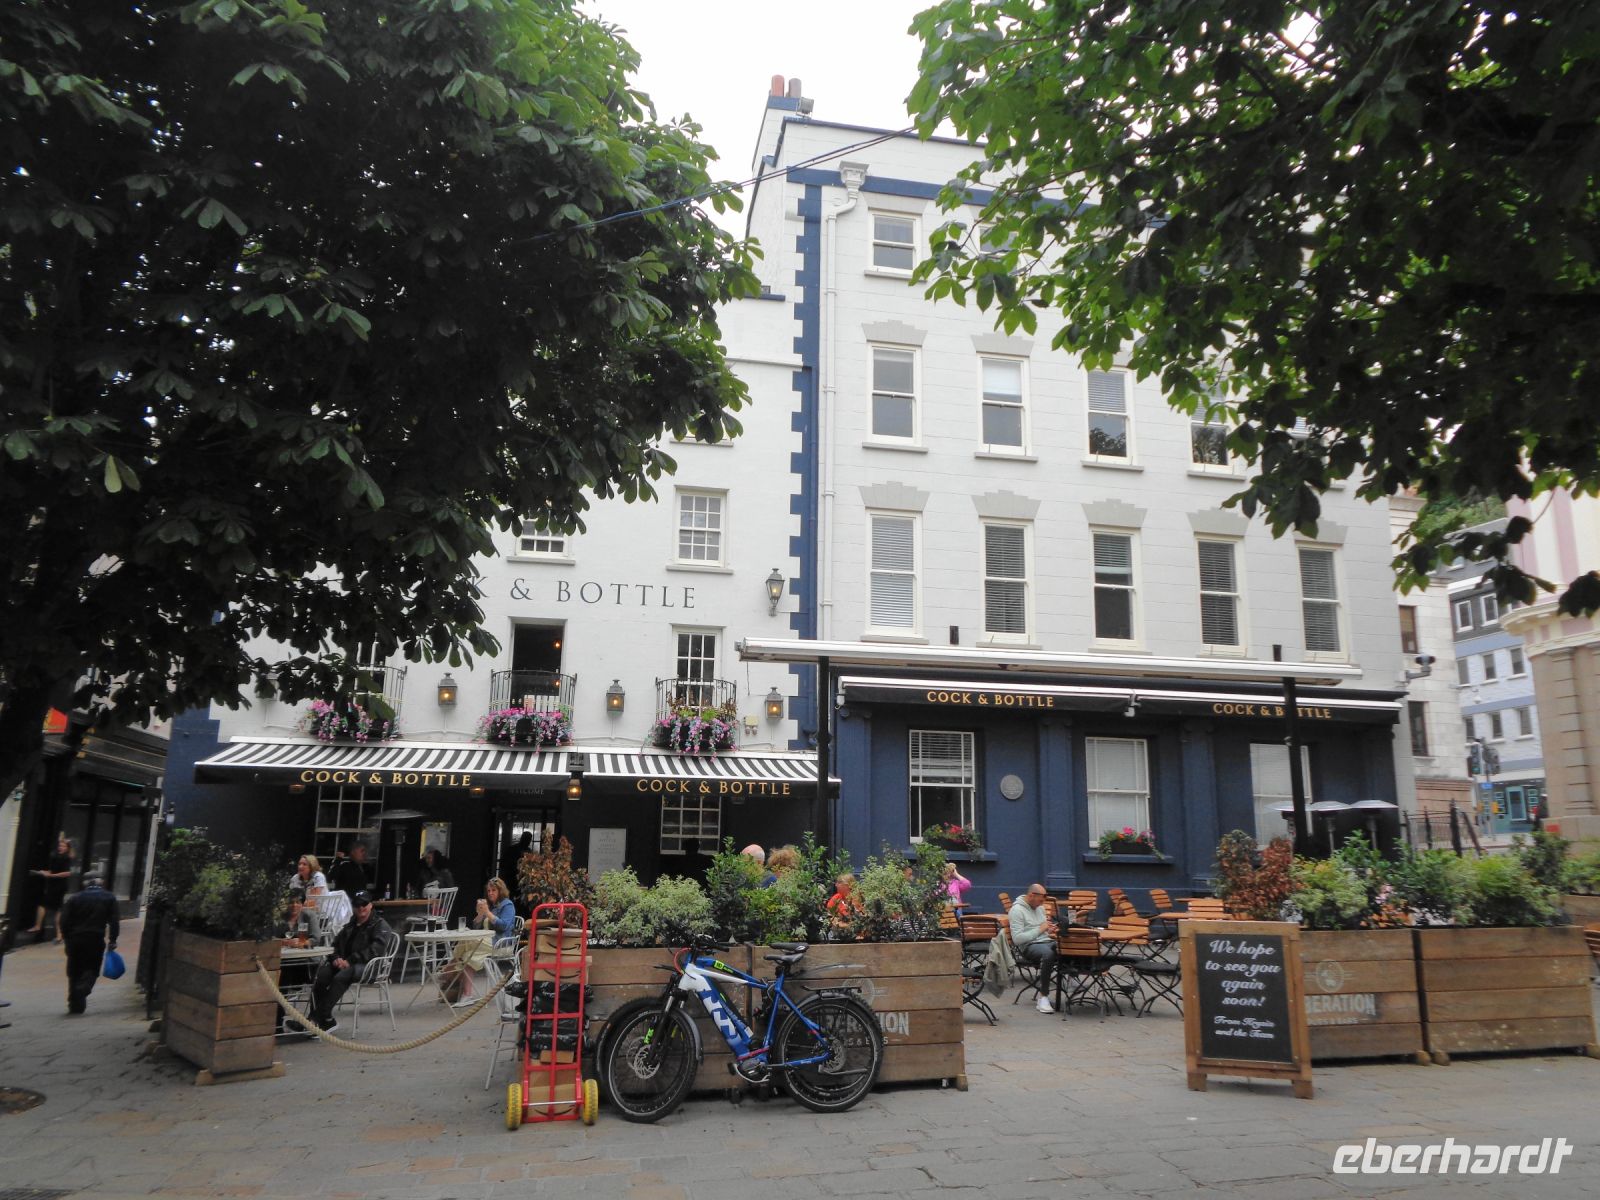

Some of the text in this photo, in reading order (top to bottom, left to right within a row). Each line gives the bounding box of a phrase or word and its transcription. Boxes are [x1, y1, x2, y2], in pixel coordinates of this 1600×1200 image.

[510, 578, 533, 600] &
[556, 580, 695, 609] BOTTLE
[927, 691, 1054, 707] COCK & BOTTLE
[1213, 703, 1331, 719] COCK & BTTLE
[301, 770, 471, 786] COCK & BOTTLE
[637, 779, 790, 795] COCK & BOTTLE
[1209, 940, 1276, 960] We hope
[1205, 960, 1282, 977] to see you
[1221, 978, 1266, 993] again
[1222, 996, 1266, 1007] soon!
